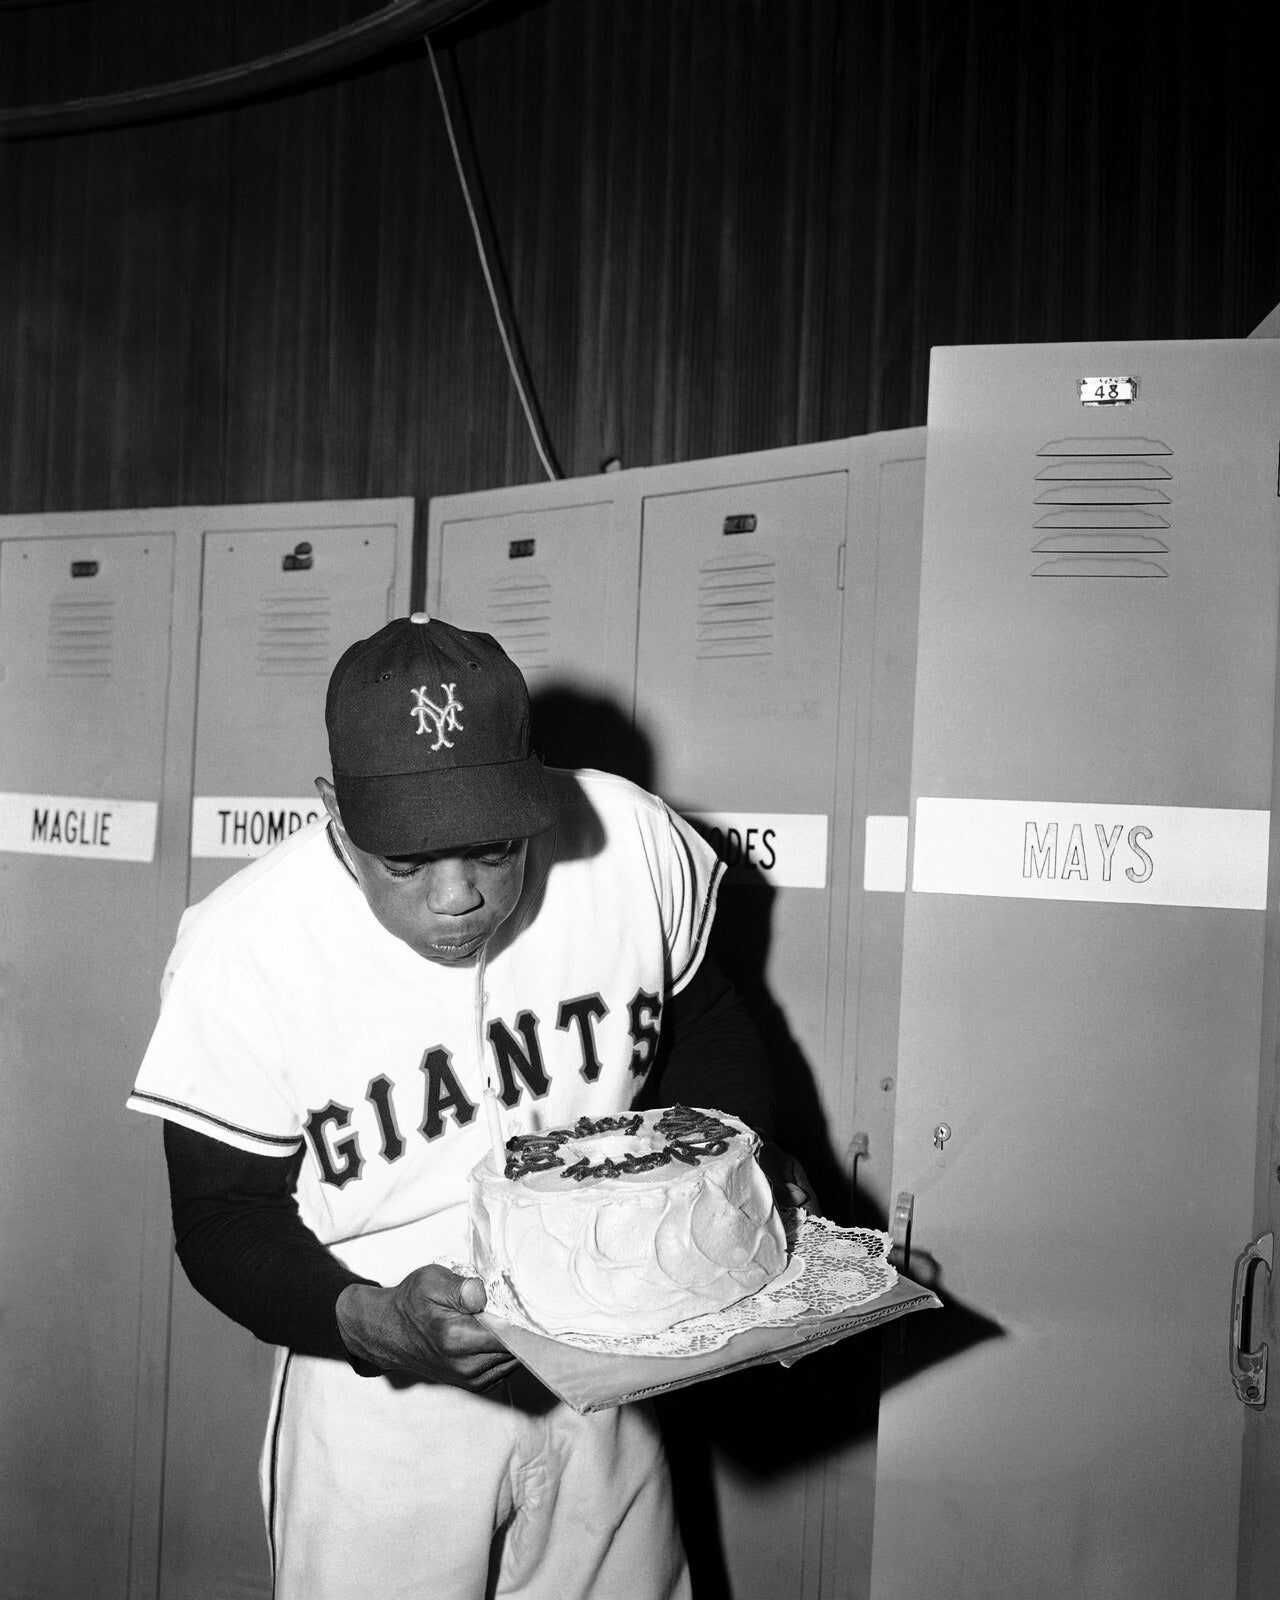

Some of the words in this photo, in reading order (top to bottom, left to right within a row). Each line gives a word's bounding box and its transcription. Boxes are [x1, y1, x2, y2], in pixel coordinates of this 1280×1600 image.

[1094, 384, 1119, 399] 48
[32, 808, 112, 846] MAGLIE
[1022, 821, 1154, 883] MAYS
[302, 987, 664, 1190] GIANTS
